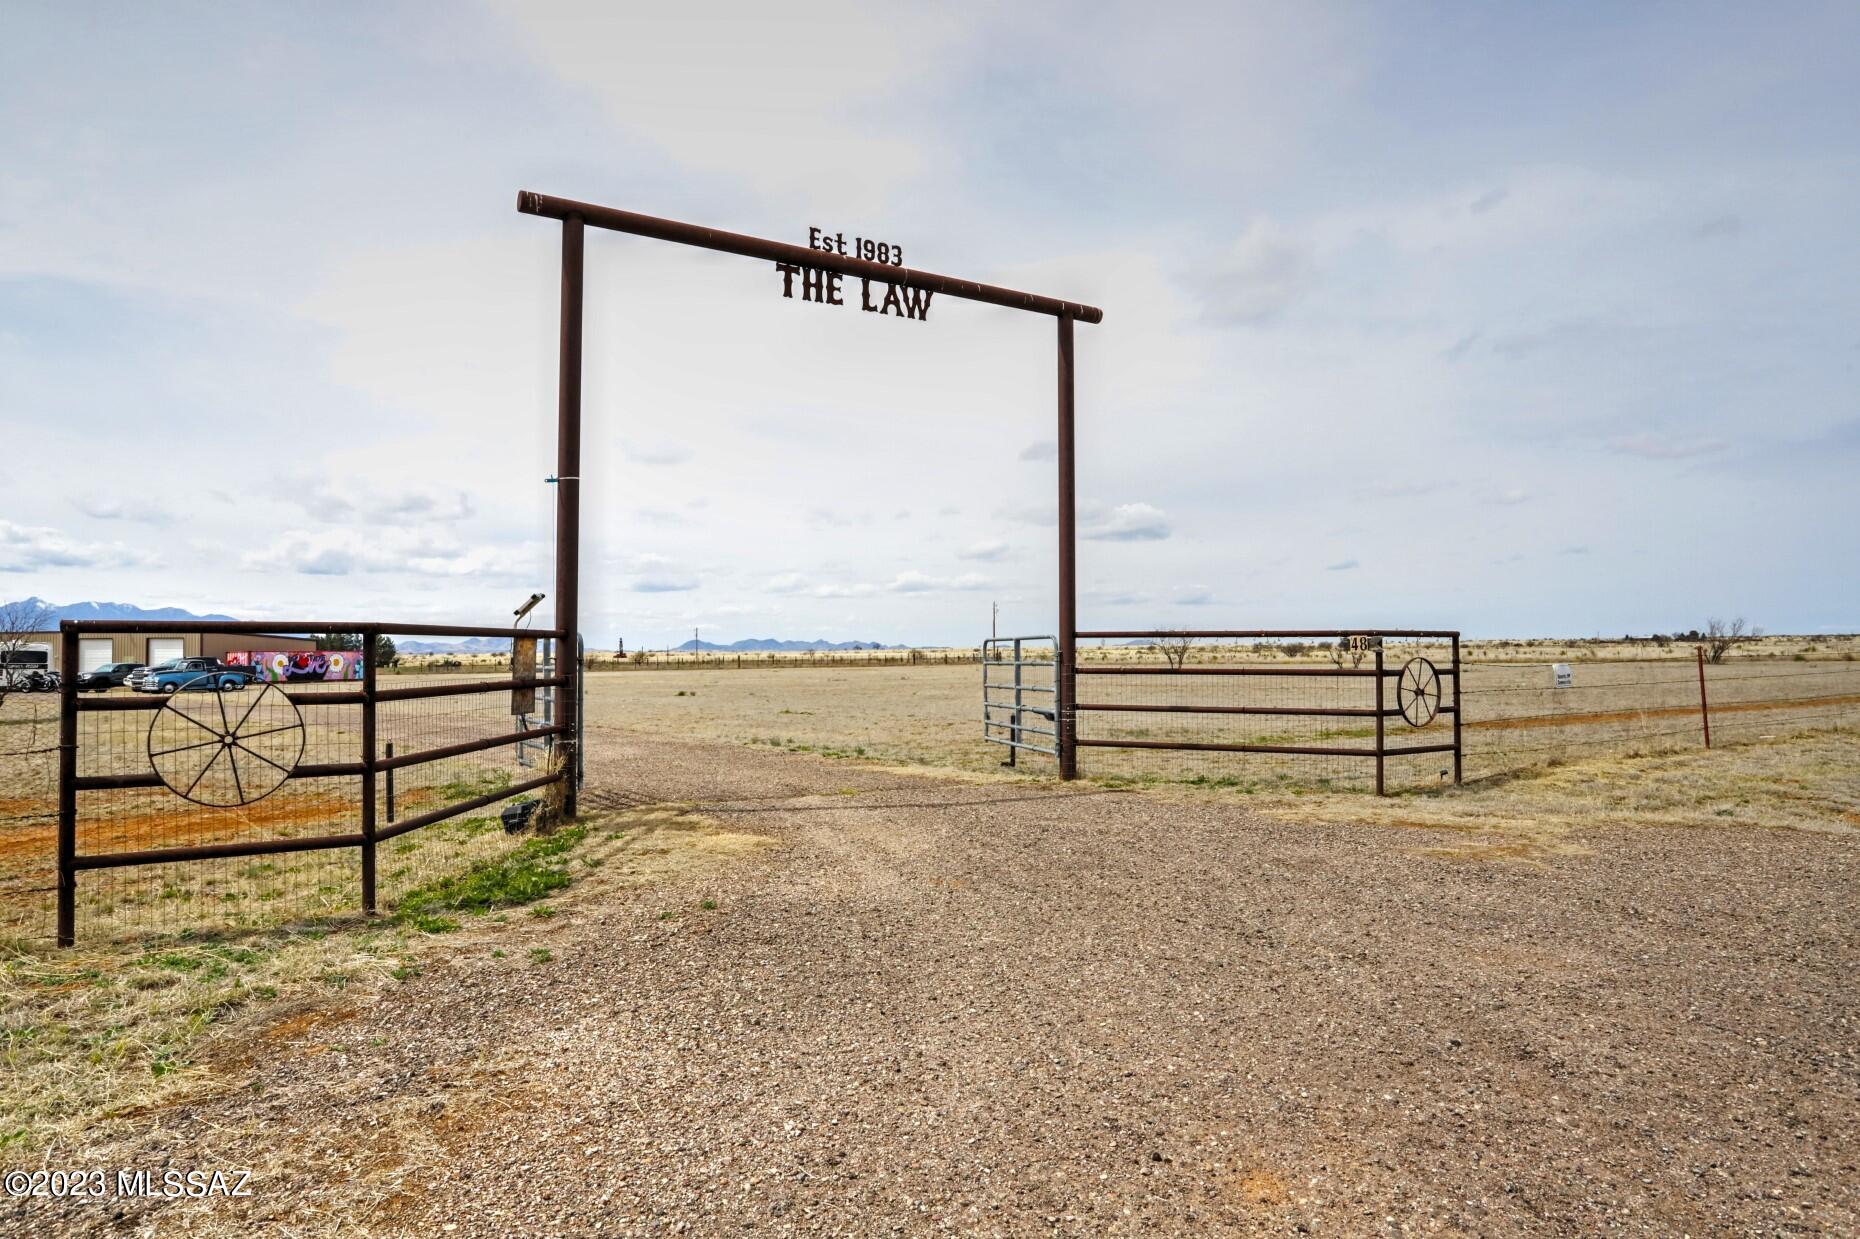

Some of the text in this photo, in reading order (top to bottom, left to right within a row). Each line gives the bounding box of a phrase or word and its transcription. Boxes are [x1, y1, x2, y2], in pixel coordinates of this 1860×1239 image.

[809, 227, 902, 267] Est 1983
[776, 261, 933, 321] THE LAW
[1351, 636, 1367, 651] 48
